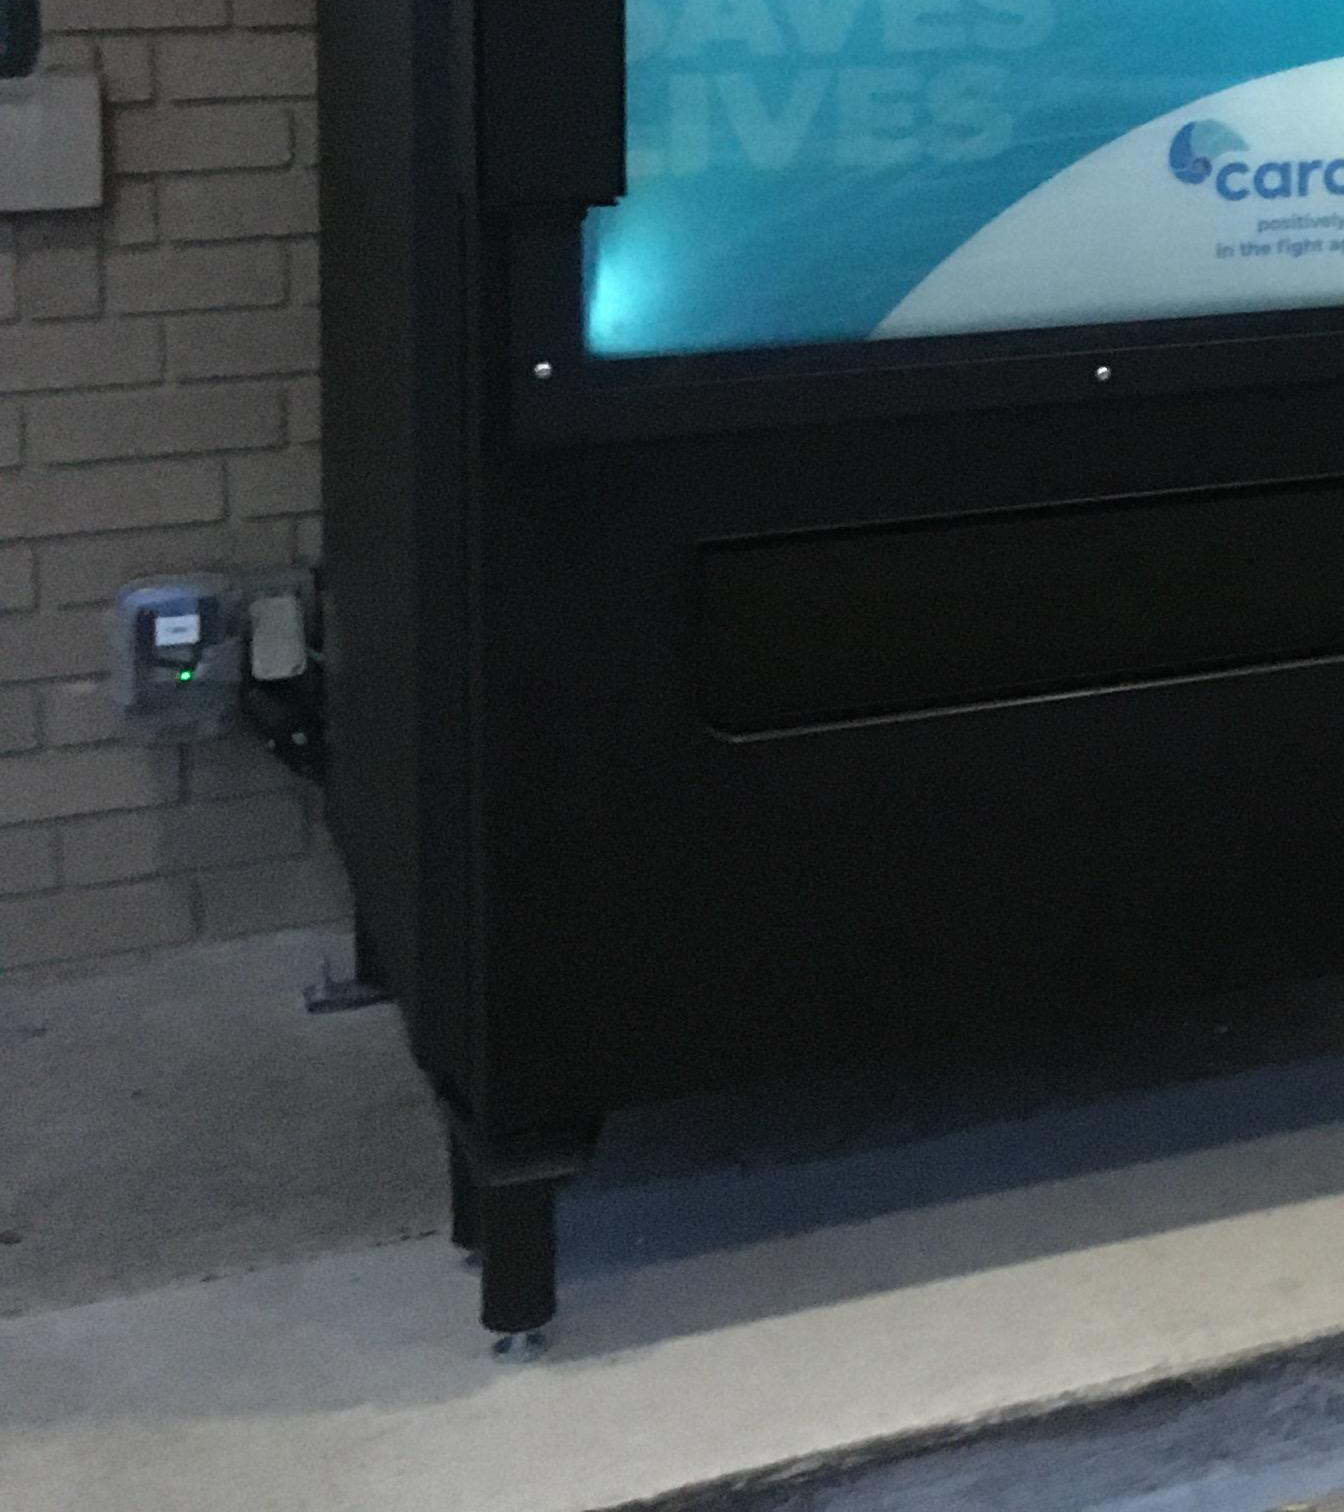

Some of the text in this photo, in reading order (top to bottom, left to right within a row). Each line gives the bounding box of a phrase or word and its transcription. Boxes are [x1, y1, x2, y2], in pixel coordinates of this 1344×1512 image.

[1215, 242, 1235, 259] in
[1240, 239, 1272, 257] the
[1276, 237, 1323, 257] fight
